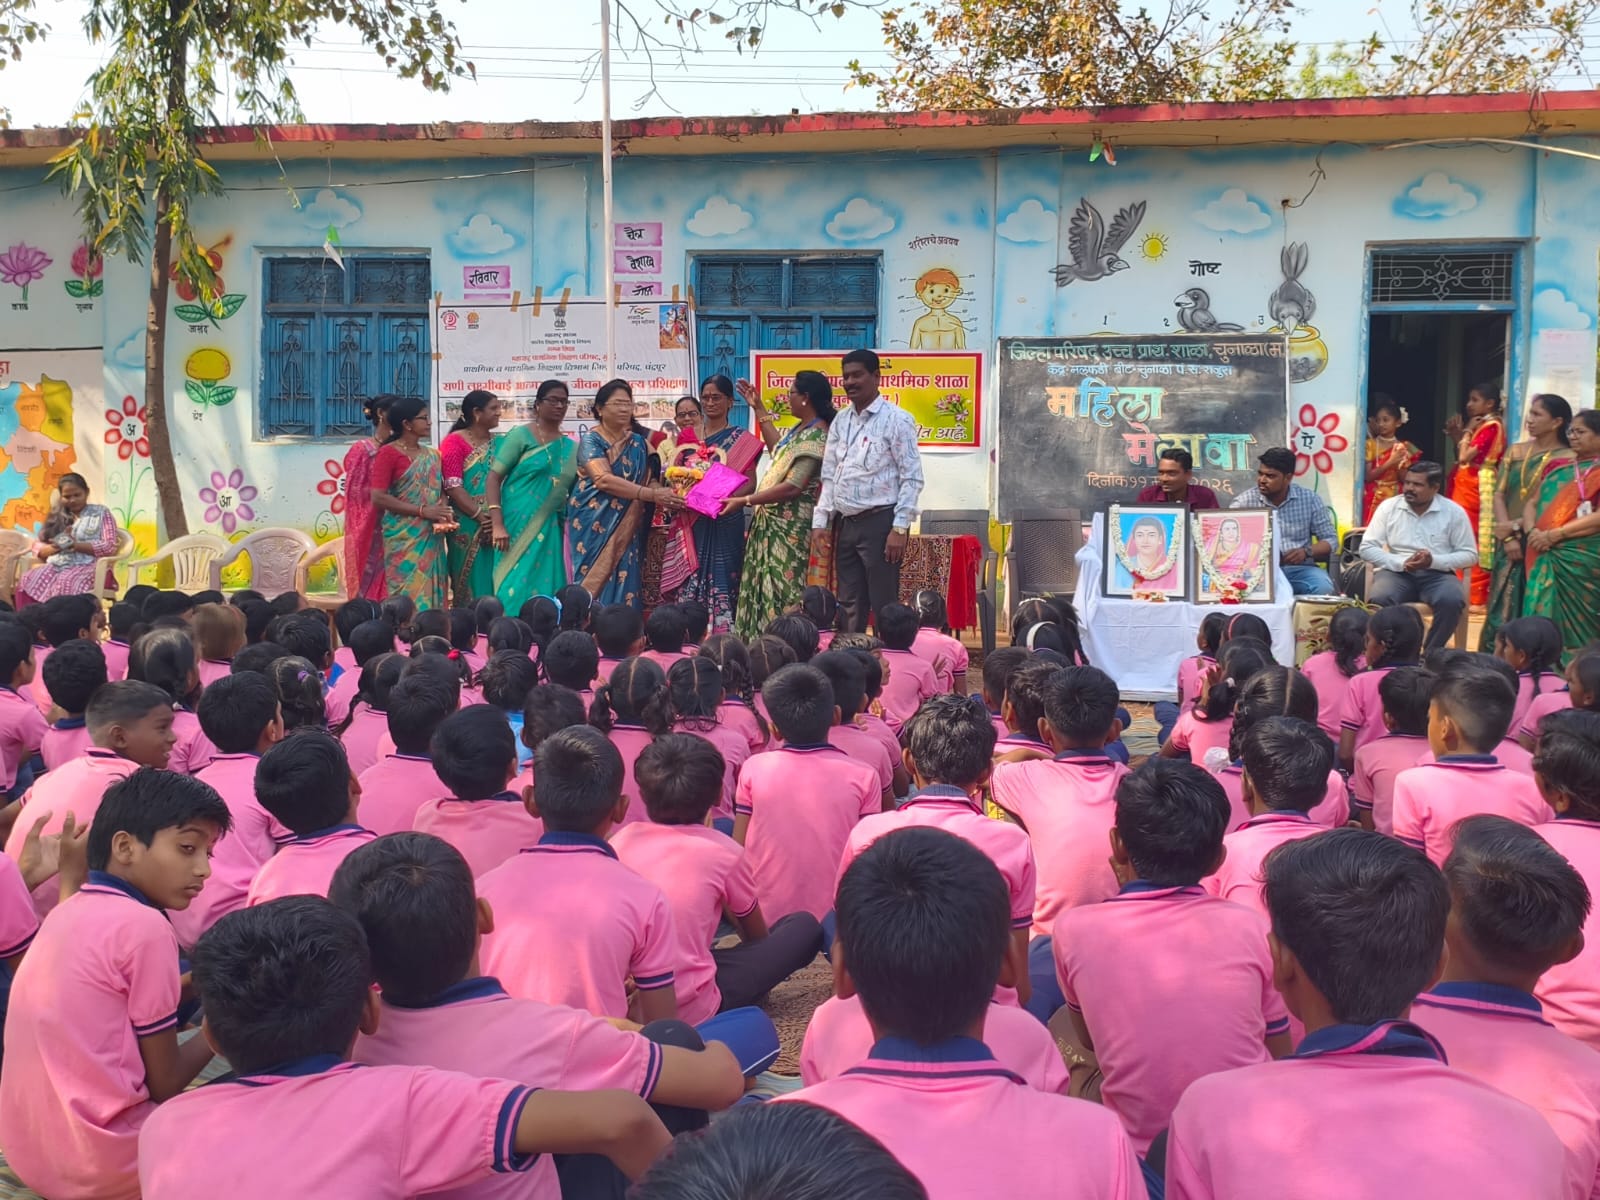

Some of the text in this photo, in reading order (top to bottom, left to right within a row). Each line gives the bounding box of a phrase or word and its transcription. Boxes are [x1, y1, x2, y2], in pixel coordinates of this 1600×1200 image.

[1189, 260, 1222, 276] गोष्ट
[469, 269, 499, 287] रविवार
[1008, 341, 1050, 362] जिल्हा
[1101, 344, 1133, 360] उच्च
[934, 375, 969, 389] शाळा
[1045, 377, 1168, 427] महिला
[126, 424, 136, 436] अ
[935, 424, 967, 440] आहे.
[1122, 421, 1257, 471] मेळावा
[1301, 431, 1315, 449] ऐ
[1088, 471, 1128, 489] दिनांक
[219, 495, 232, 508] आ
